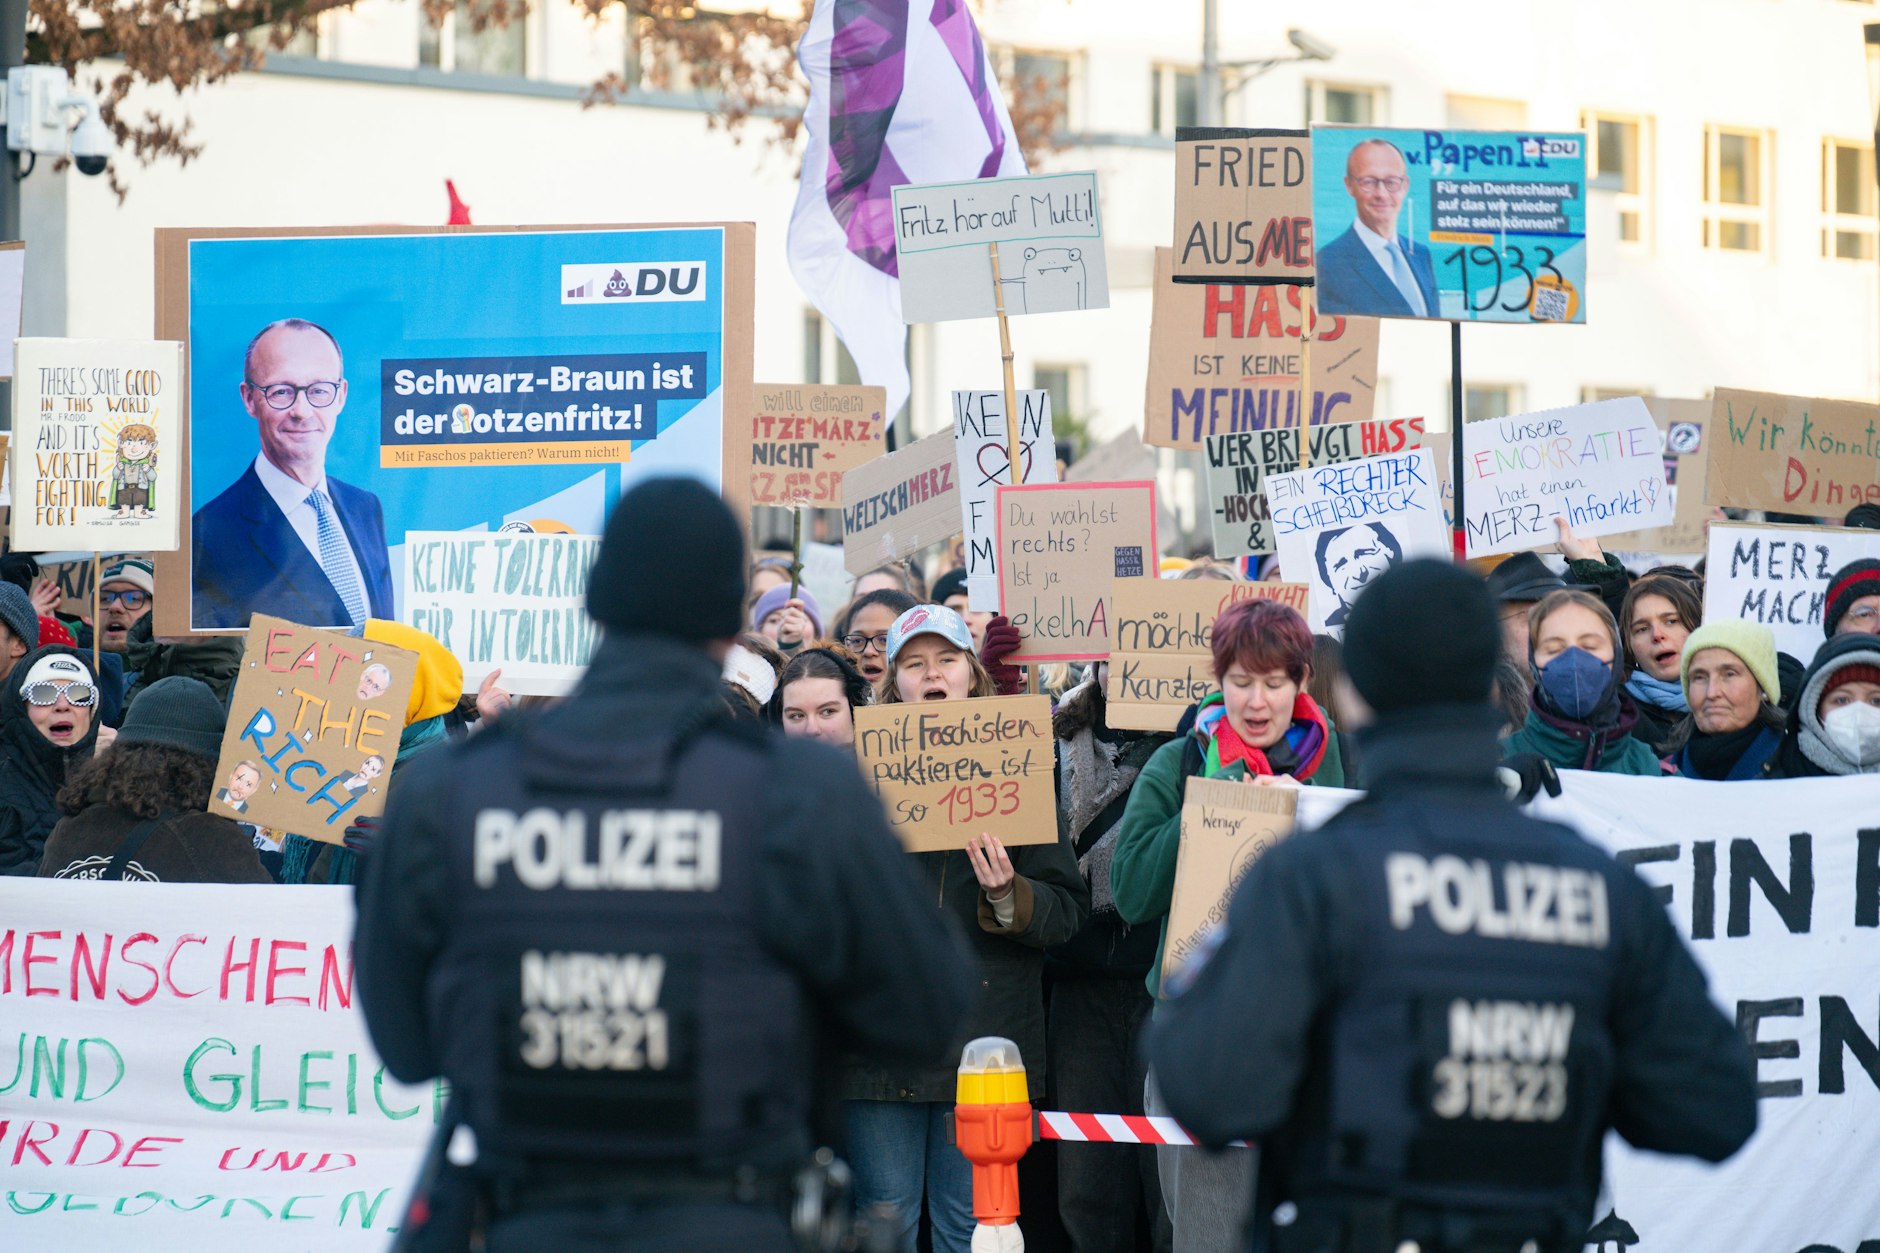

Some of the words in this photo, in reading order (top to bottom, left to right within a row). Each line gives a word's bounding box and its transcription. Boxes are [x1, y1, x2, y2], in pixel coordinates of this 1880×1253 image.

[1194, 145, 1304, 187] FRIED
[1423, 130, 1513, 173] Papen
[1436, 181, 1460, 195] Für
[1460, 182, 1482, 195] ein
[1484, 181, 1573, 199] Deutschland,
[1437, 199, 1459, 212] auf
[1461, 199, 1486, 212] das
[1487, 199, 1508, 213] wir
[1512, 200, 1557, 213] wieder
[900, 205, 948, 238] Fritz,
[953, 197, 988, 232] hör
[991, 194, 1020, 227] auf
[1031, 189, 1095, 228] Mutti!
[1438, 215, 1470, 228] stolz
[1472, 215, 1499, 228] sein
[1182, 216, 1315, 268] AUSME
[1444, 244, 1564, 316] 1933
[38, 368, 87, 395] THERE'S
[92, 368, 121, 395] SOME
[126, 369, 161, 396] GOOD
[394, 364, 645, 396] Schwarz-Braun
[652, 361, 694, 391] ist
[1193, 355, 1224, 376] IST
[1242, 354, 1300, 376] KEINE
[41, 397, 53, 412] IN
[64, 397, 93, 412] THIS
[58, 413, 86, 422] FRODO
[394, 408, 447, 435] der
[453, 402, 643, 434] otzenfritz!
[763, 390, 804, 412] will
[810, 391, 863, 412] einen
[958, 391, 1045, 438] KEN
[36, 425, 67, 450] AND
[74, 425, 100, 450] IT'S
[1206, 433, 1253, 468] WER
[1361, 416, 1424, 455] HASS
[1728, 400, 1785, 451] Wir
[36, 452, 100, 479] WORTH
[394, 450, 415, 462] Mit
[417, 449, 466, 462] Faschos
[469, 448, 534, 464] paktieren?
[537, 447, 582, 460] Warum
[585, 446, 620, 459] nicht!
[752, 442, 820, 469] NICHT
[36, 480, 107, 507] FIGHTING
[1235, 466, 1259, 494] IN
[1271, 475, 1305, 501] EIN
[1313, 454, 1427, 496] RECHTER
[1496, 482, 1530, 505] hat
[1540, 478, 1587, 495] einen
[36, 506, 77, 527] FOR!
[843, 462, 954, 536] WELTSCHMERZ
[1009, 502, 1035, 527] Du
[1050, 499, 1119, 524] wählst
[413, 540, 486, 594] KEINE
[493, 538, 602, 597] TOLERAN
[1115, 547, 1141, 556] GEGEN
[1117, 566, 1142, 577] HETZE
[1730, 537, 1833, 581] MERZ
[1012, 562, 1032, 587] Ist
[1043, 568, 1061, 591] ja
[413, 602, 454, 653] FÜR
[469, 607, 603, 667] INTOLERAN
[1118, 612, 1213, 650] möchte
[265, 628, 360, 684] EAT
[1121, 660, 1213, 701] Kanzler
[292, 687, 392, 756] THE
[862, 713, 914, 757] mit
[919, 711, 1046, 751] Faschisten
[240, 707, 359, 825] RICH
[873, 753, 992, 796] paktieren
[1001, 748, 1036, 777] ist
[891, 799, 928, 826] so
[937, 780, 1021, 826] 1933
[474, 806, 722, 892] POLIZEI
[1385, 852, 1610, 950] POLIZEI
[520, 949, 666, 1010] NRW
[519, 1008, 669, 1071] 31521
[1449, 997, 1575, 1062] NRW
[1431, 1055, 1568, 1122] 31523
[0, 1120, 185, 1168] RDE
